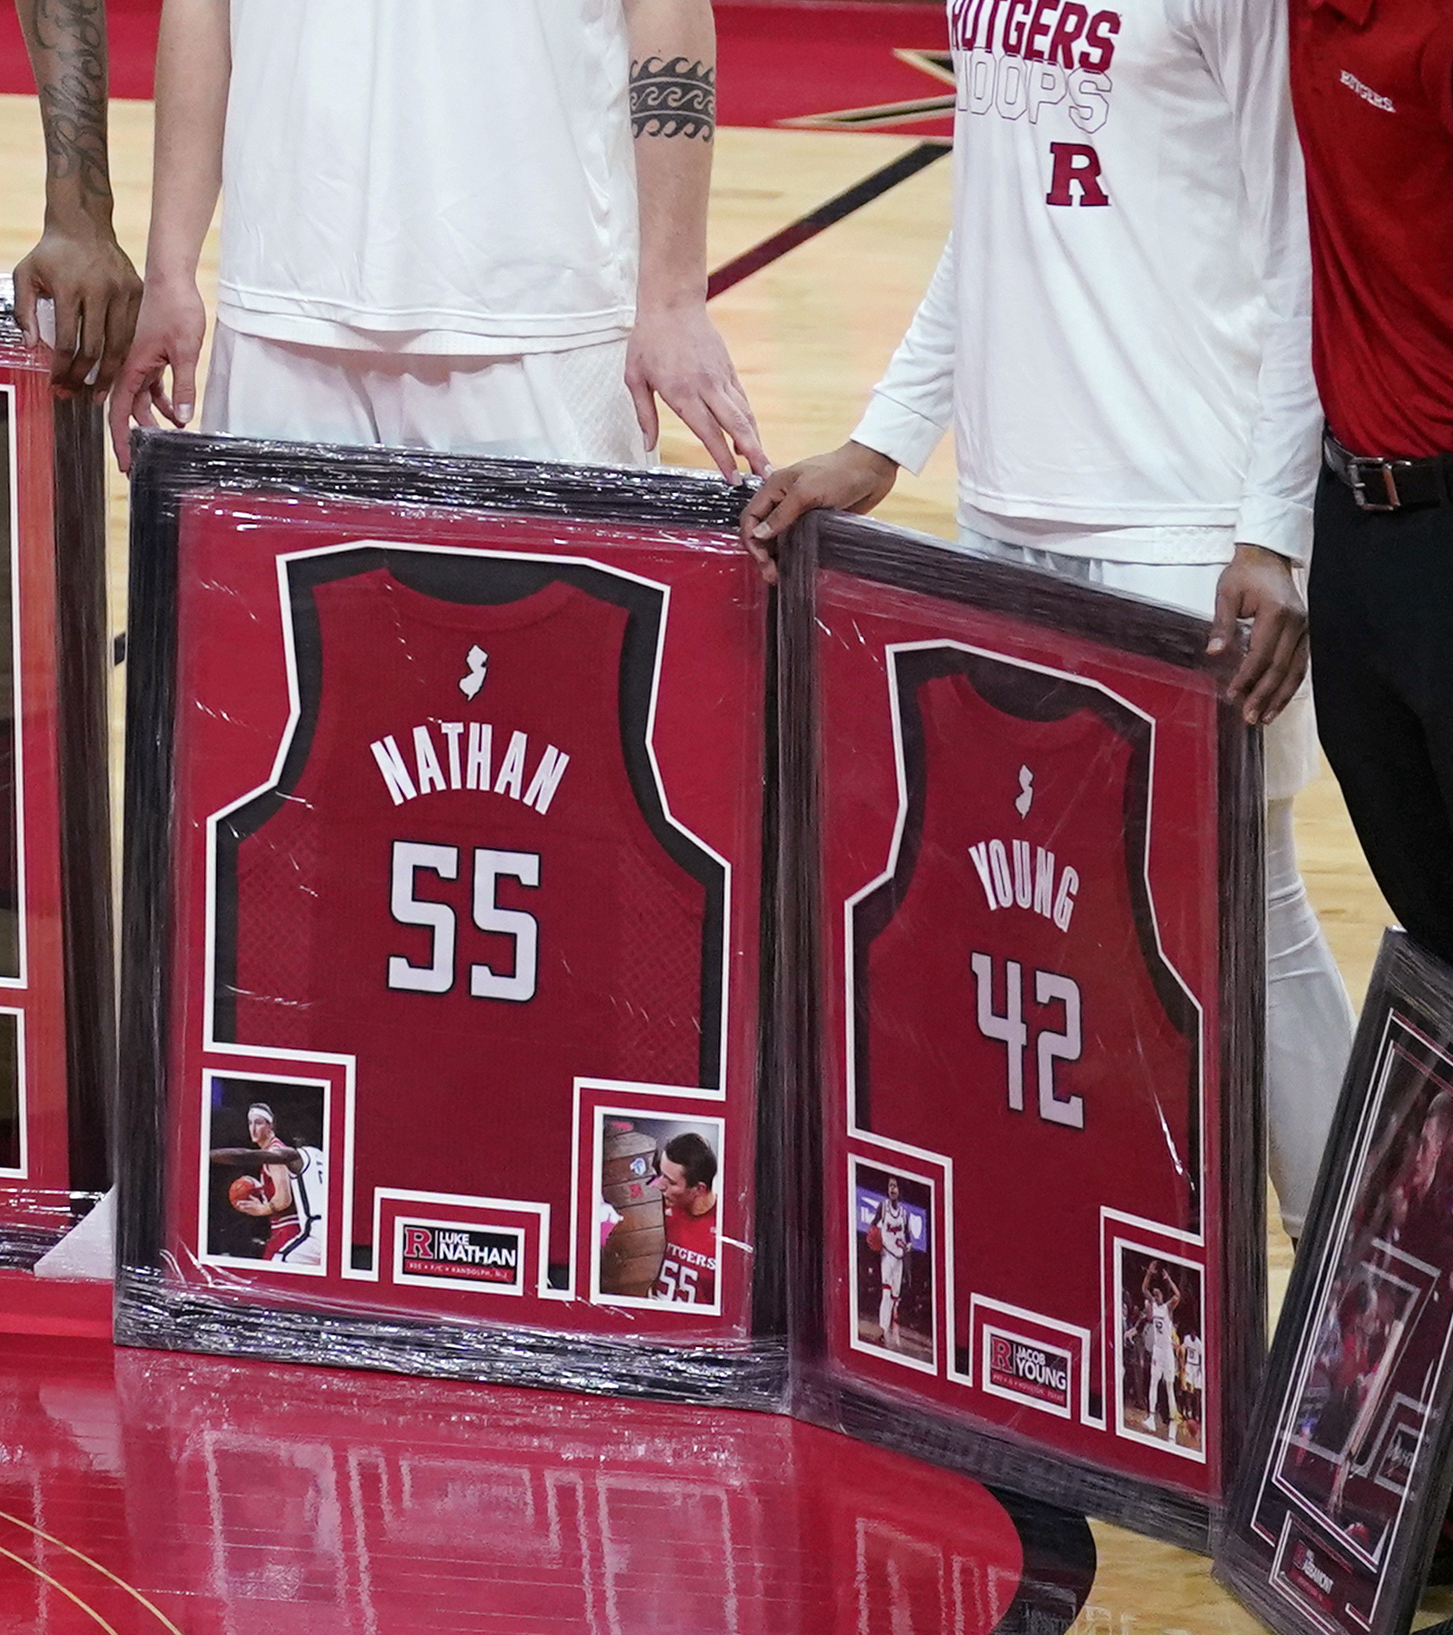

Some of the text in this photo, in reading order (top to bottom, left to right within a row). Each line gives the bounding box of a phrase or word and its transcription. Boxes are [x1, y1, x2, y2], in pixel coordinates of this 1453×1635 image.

[1046, 142, 1109, 207] R
[370, 721, 571, 816] NATHAN
[969, 839, 1081, 933] YOUNG
[387, 839, 542, 1004] 55
[970, 951, 1084, 1130] 42
[404, 1227, 433, 1259] R
[439, 1231, 470, 1245] LUKE
[439, 1244, 516, 1267] NATHAN
[659, 1259, 699, 1304] 55
[991, 1337, 1013, 1373] R
[1016, 1346, 1046, 1365] JACOB
[1017, 1358, 1066, 1390] YOUNG
